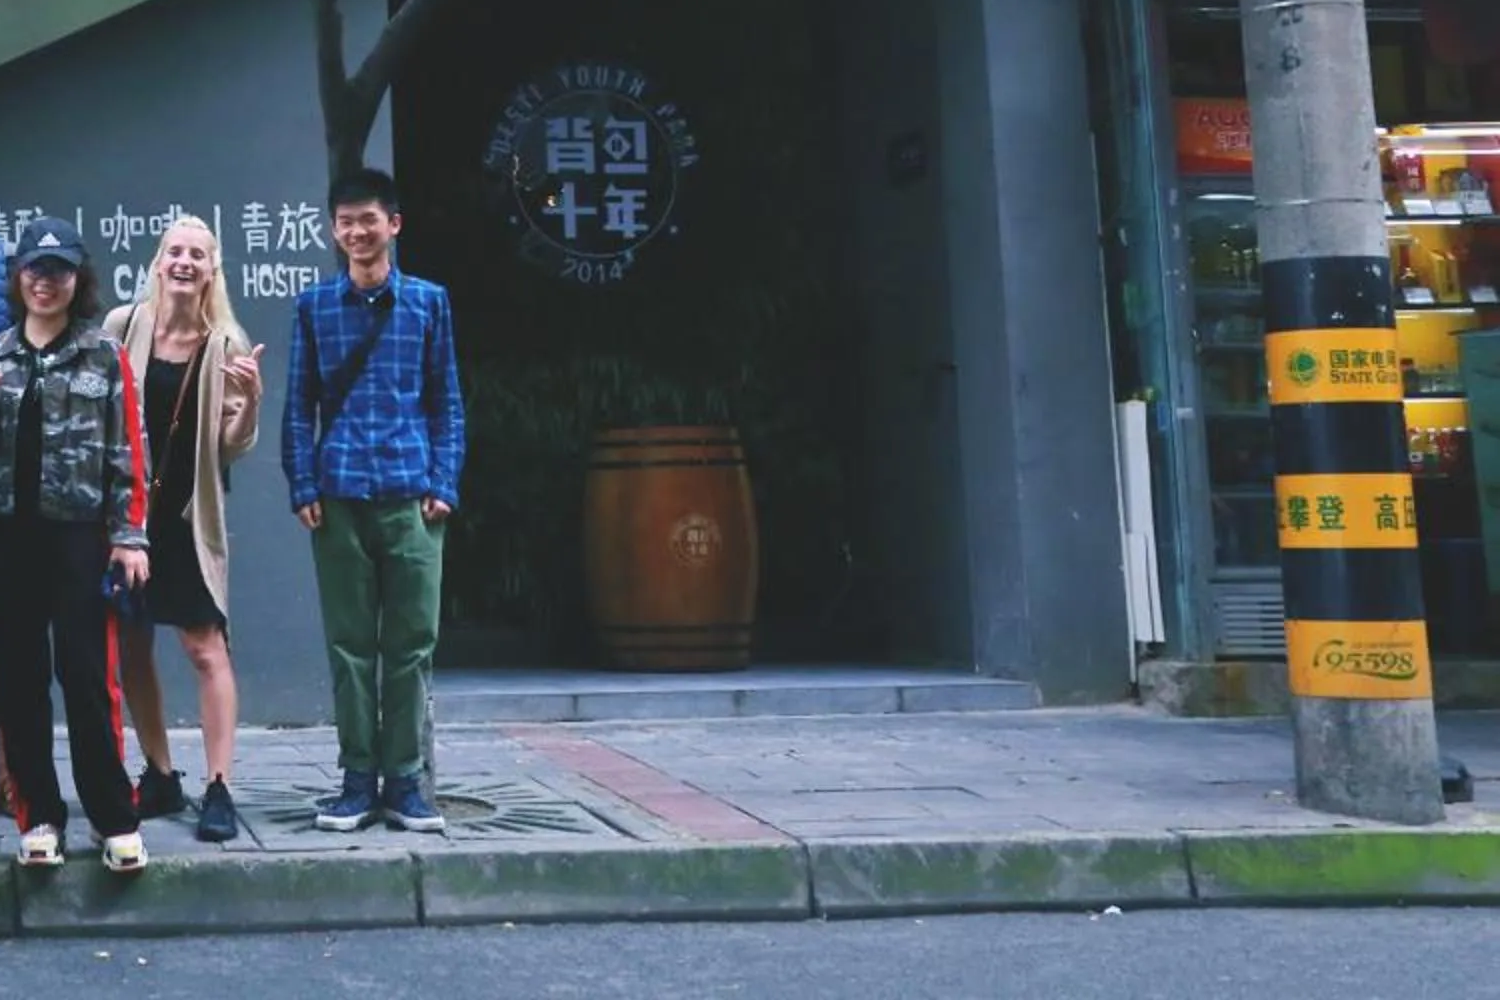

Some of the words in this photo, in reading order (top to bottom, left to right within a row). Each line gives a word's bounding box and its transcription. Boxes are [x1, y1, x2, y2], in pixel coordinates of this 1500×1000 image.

[557, 64, 646, 99] YOUTH
[545, 115, 649, 175] 背包
[241, 201, 327, 253] 青旅
[542, 181, 650, 240] 十年
[560, 257, 625, 285] 2014
[1278, 494, 1347, 533] 攀登
[1325, 651, 1414, 674] 95598
